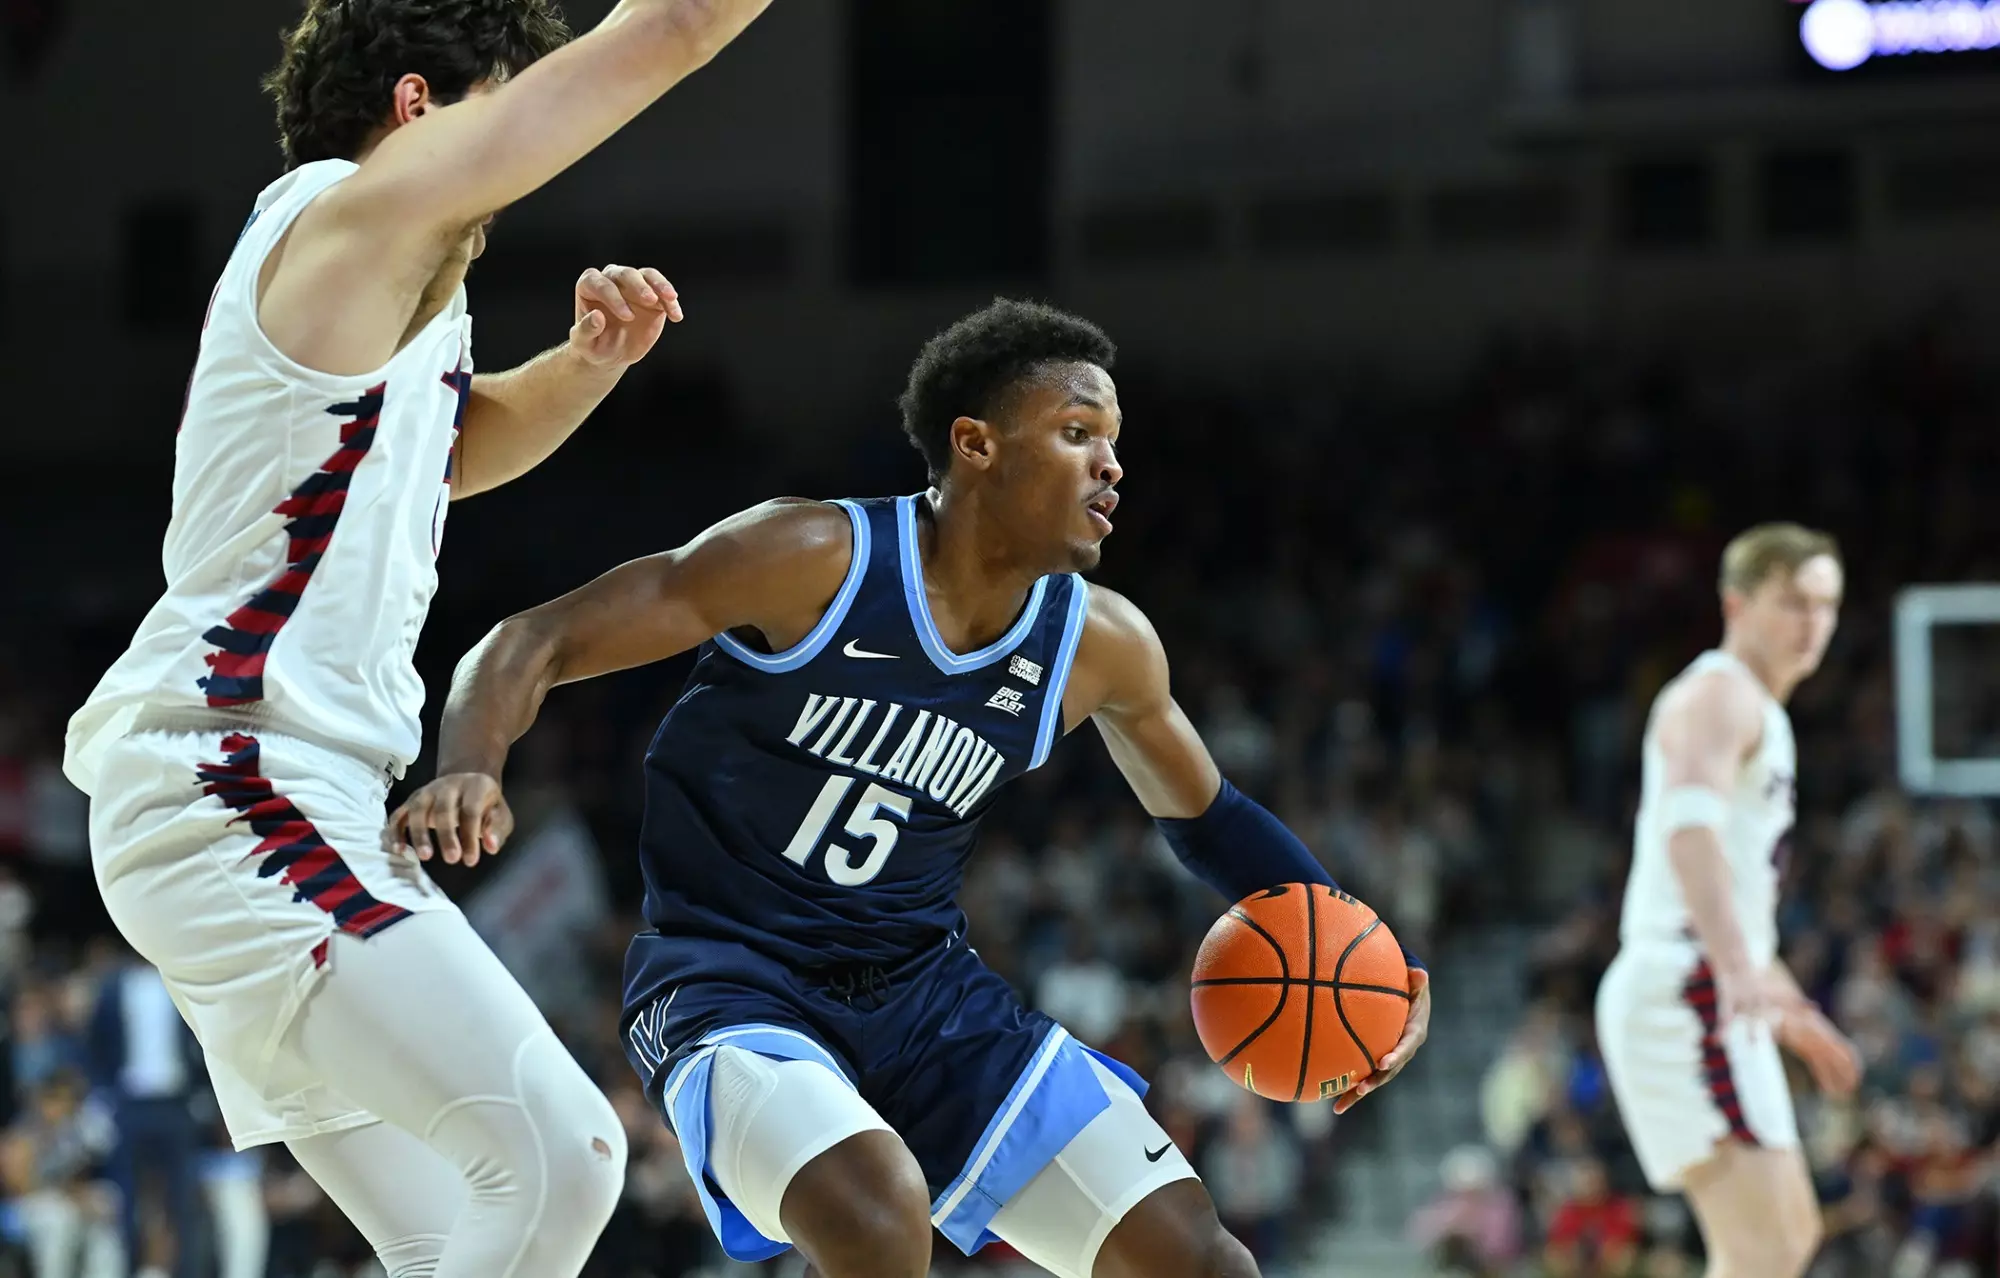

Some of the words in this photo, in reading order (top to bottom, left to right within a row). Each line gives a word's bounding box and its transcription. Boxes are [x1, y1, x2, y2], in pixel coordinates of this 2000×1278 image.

[1008, 666, 1041, 686] CHANGE
[989, 694, 1026, 712] EAST
[996, 686, 1023, 702] BIG
[784, 693, 1005, 819] VILLANOVA
[781, 774, 913, 887] 15
